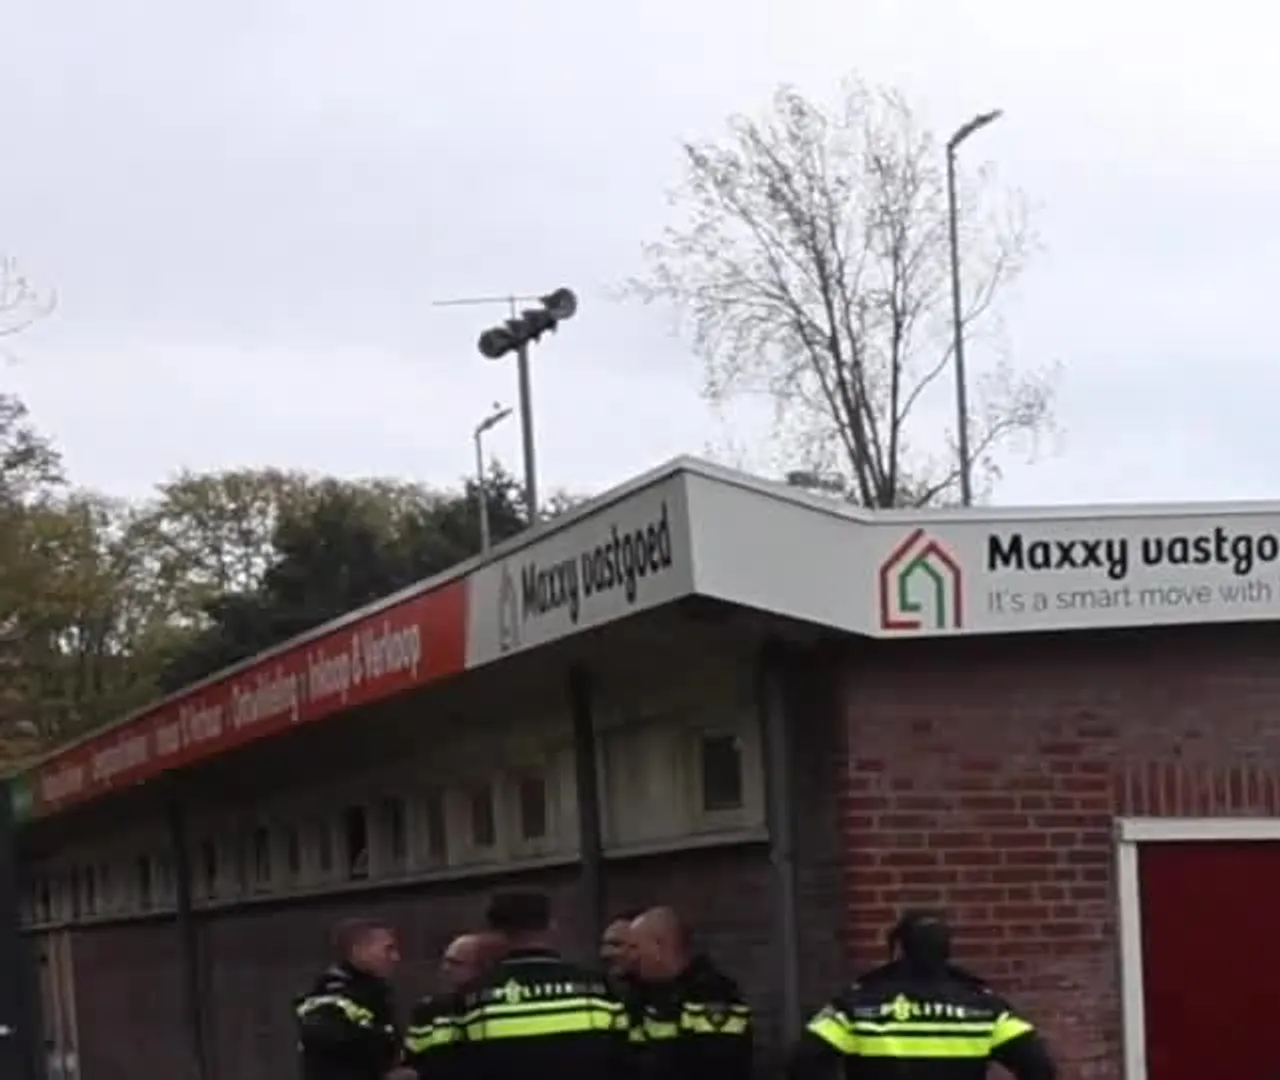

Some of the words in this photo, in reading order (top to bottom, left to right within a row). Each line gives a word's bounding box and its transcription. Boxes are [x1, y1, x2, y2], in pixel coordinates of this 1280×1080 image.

[521, 558, 580, 626] Maxxy
[581, 500, 673, 604] vastgoed
[987, 533, 1128, 580] Maxxy
[987, 588, 1027, 613] It's
[1032, 593, 1048, 611] a
[1056, 587, 1133, 610] smart
[1140, 585, 1213, 606] move
[1218, 577, 1273, 604] with
